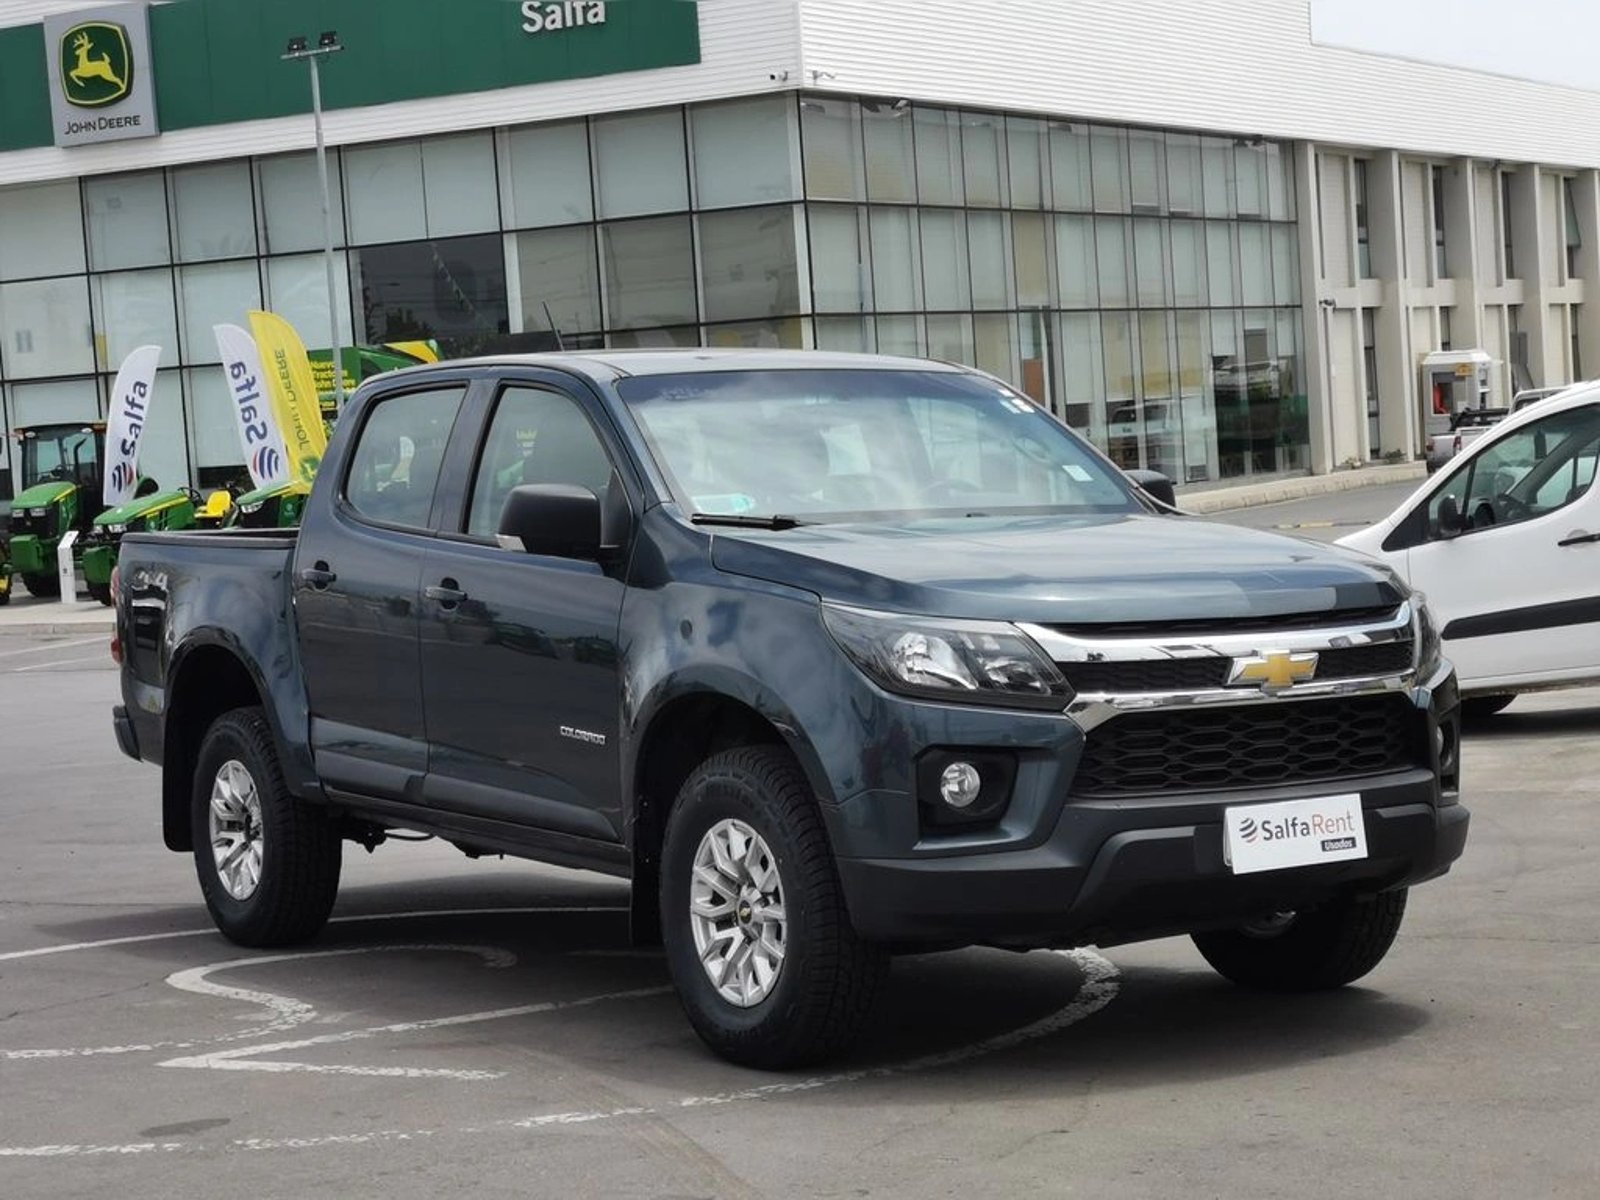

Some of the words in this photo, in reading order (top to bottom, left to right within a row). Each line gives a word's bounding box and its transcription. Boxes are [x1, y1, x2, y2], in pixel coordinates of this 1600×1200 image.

[521, 0, 605, 32] Salfa
[64, 121, 96, 135] JOHN
[98, 115, 141, 130] DEERE
[120, 381, 148, 459] Salfa
